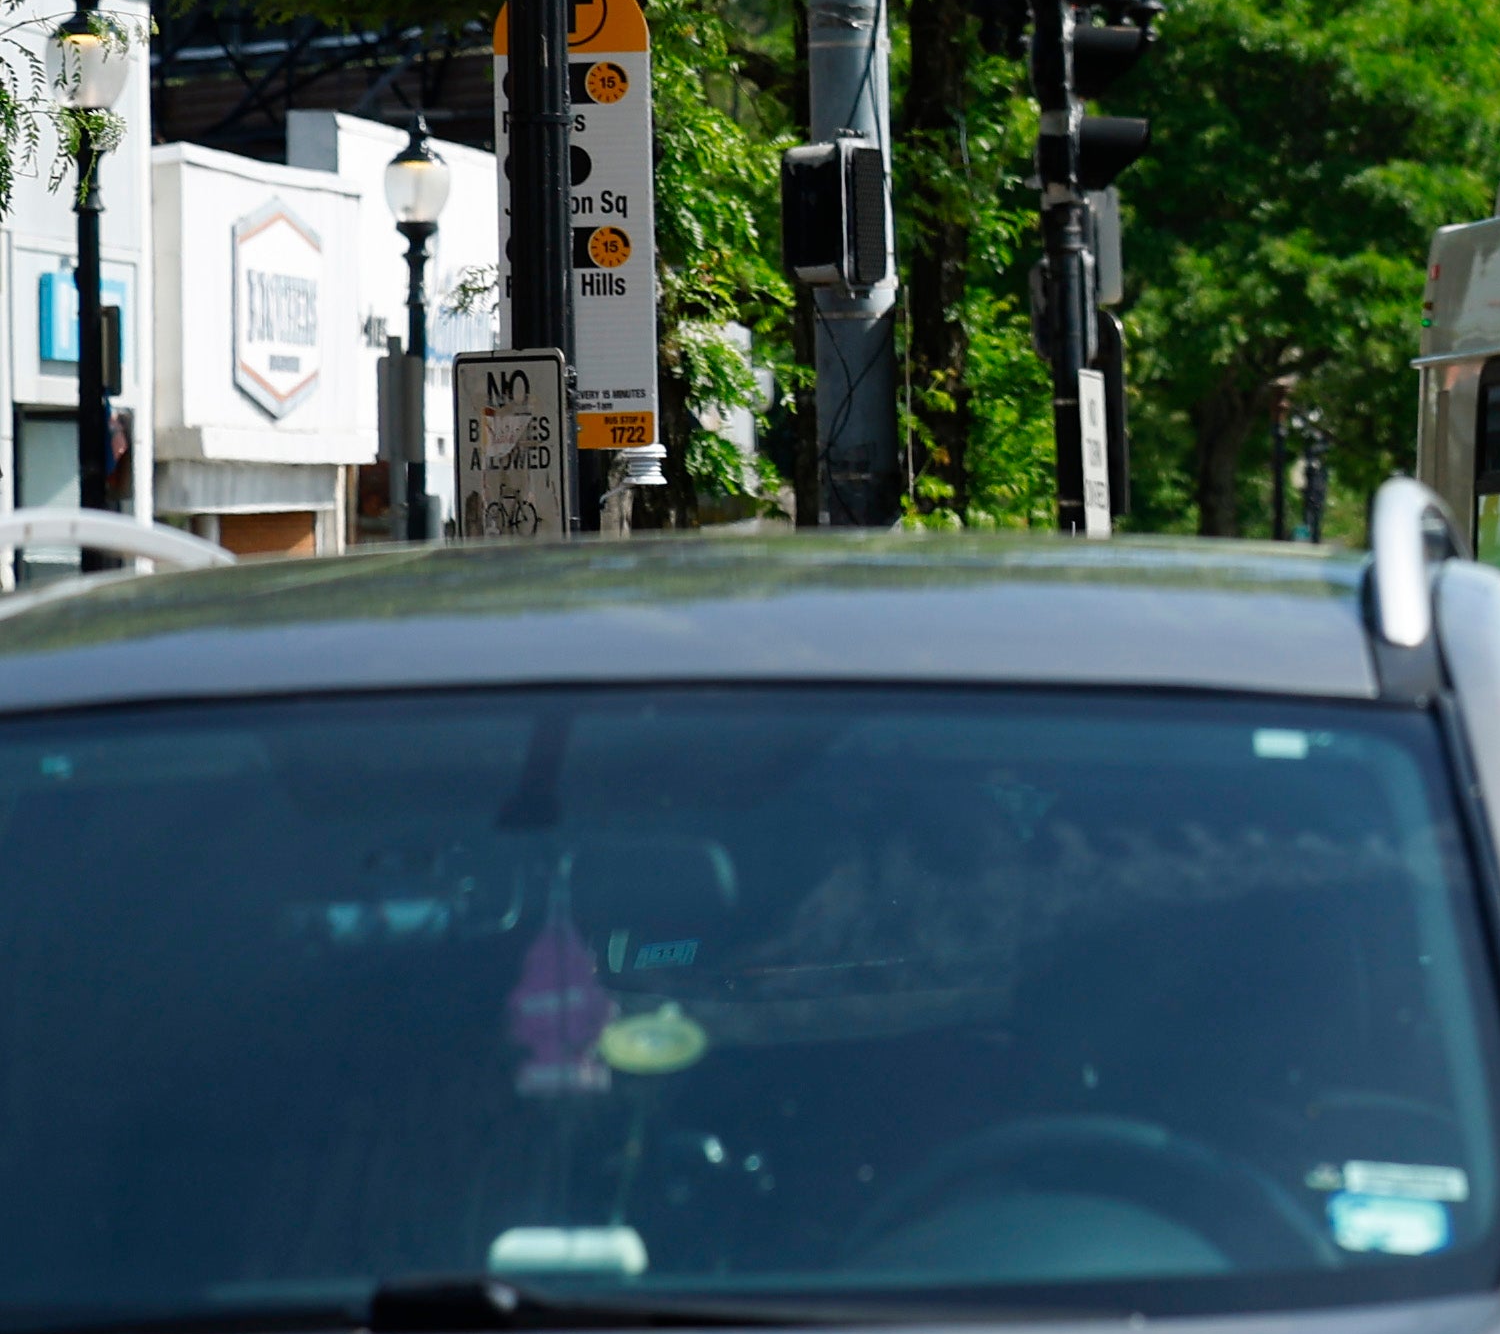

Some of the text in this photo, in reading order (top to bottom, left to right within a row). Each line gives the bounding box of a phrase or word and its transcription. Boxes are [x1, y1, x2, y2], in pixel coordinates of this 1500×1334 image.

[600, 76, 616, 90] 15
[600, 191, 628, 218] Sq
[602, 240, 619, 254] 15
[581, 273, 627, 297] Hills
[486, 369, 530, 407] NO
[576, 388, 647, 400] EVERY 15 MINUTES
[604, 416, 618, 425] BUS
[620, 415, 638, 425] STOP
[611, 426, 646, 444] 1722
